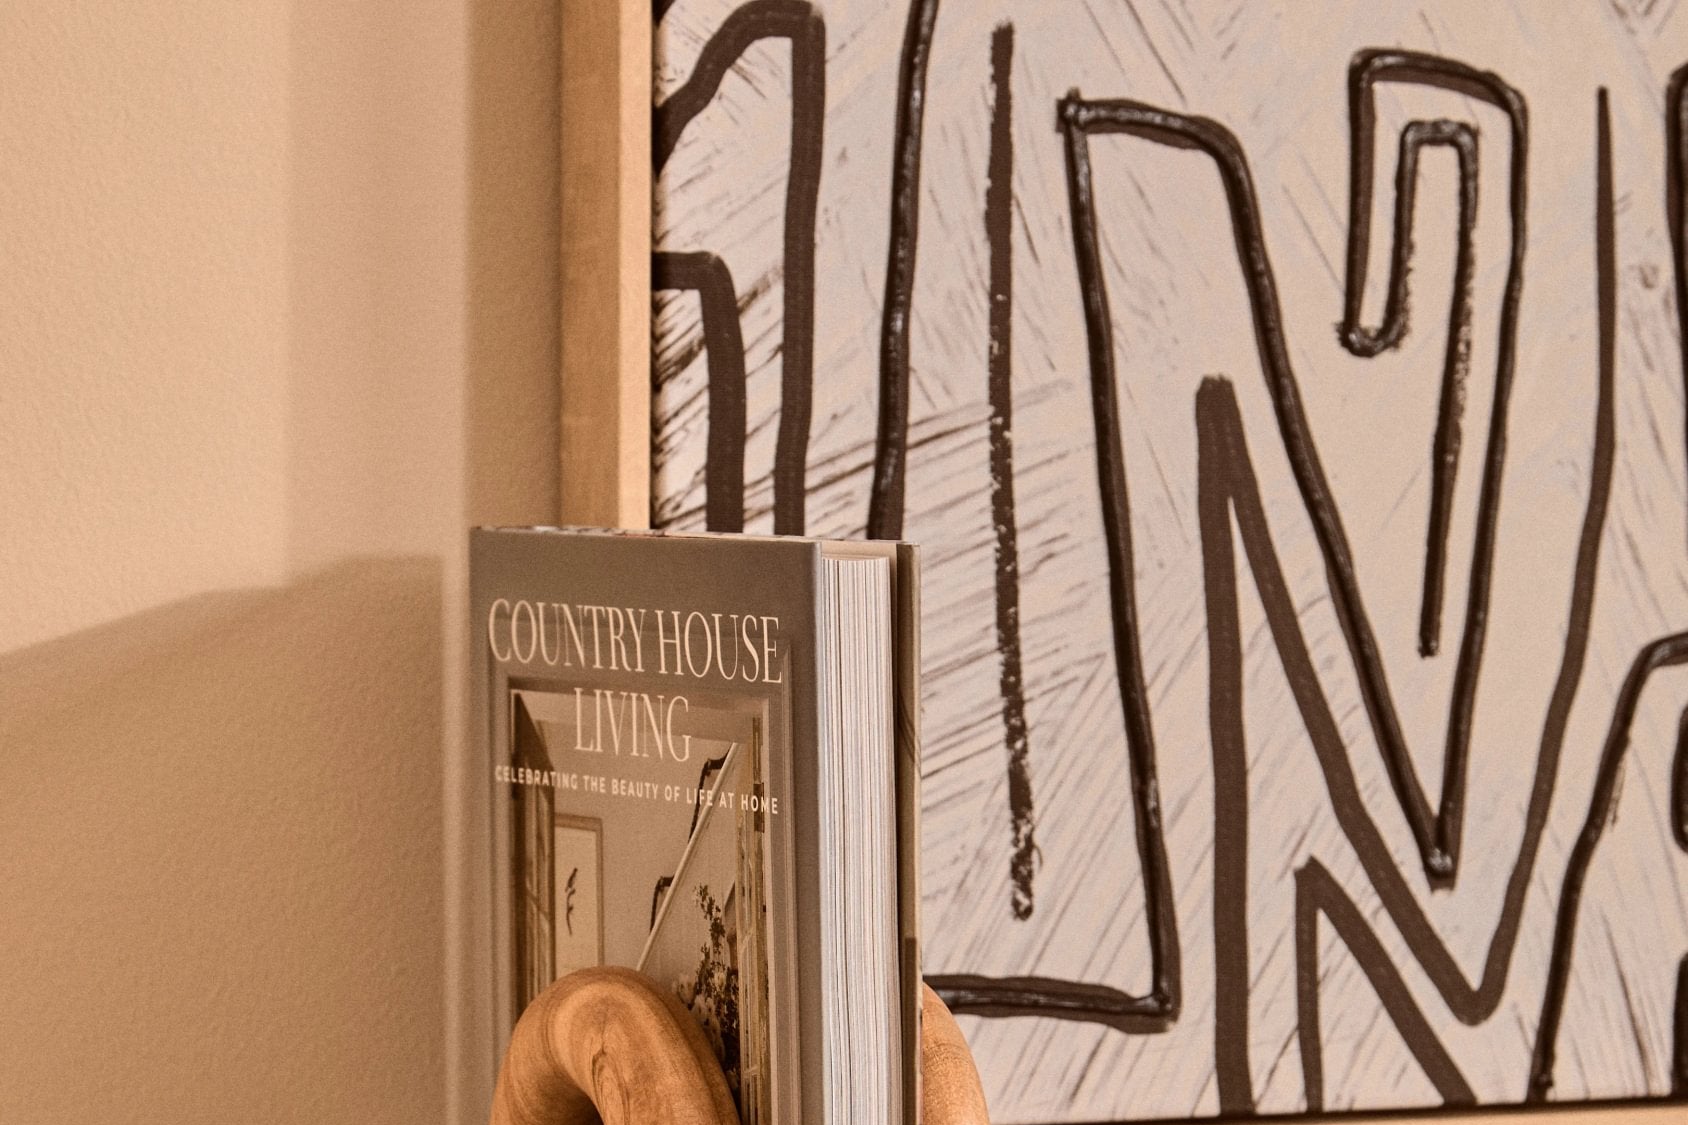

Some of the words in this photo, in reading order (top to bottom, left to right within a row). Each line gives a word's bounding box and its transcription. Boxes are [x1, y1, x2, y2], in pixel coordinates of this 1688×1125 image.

[488, 598, 647, 673] COUNTRY
[654, 609, 782, 684] HOUSE
[573, 687, 691, 762] LIVING
[495, 764, 578, 790] CELEBRATING
[583, 775, 606, 793] THE
[611, 778, 659, 800] BEAUTY
[664, 784, 681, 802] OF
[686, 787, 713, 806] LIFE
[719, 791, 735, 809] AT
[741, 794, 779, 814] HOME
